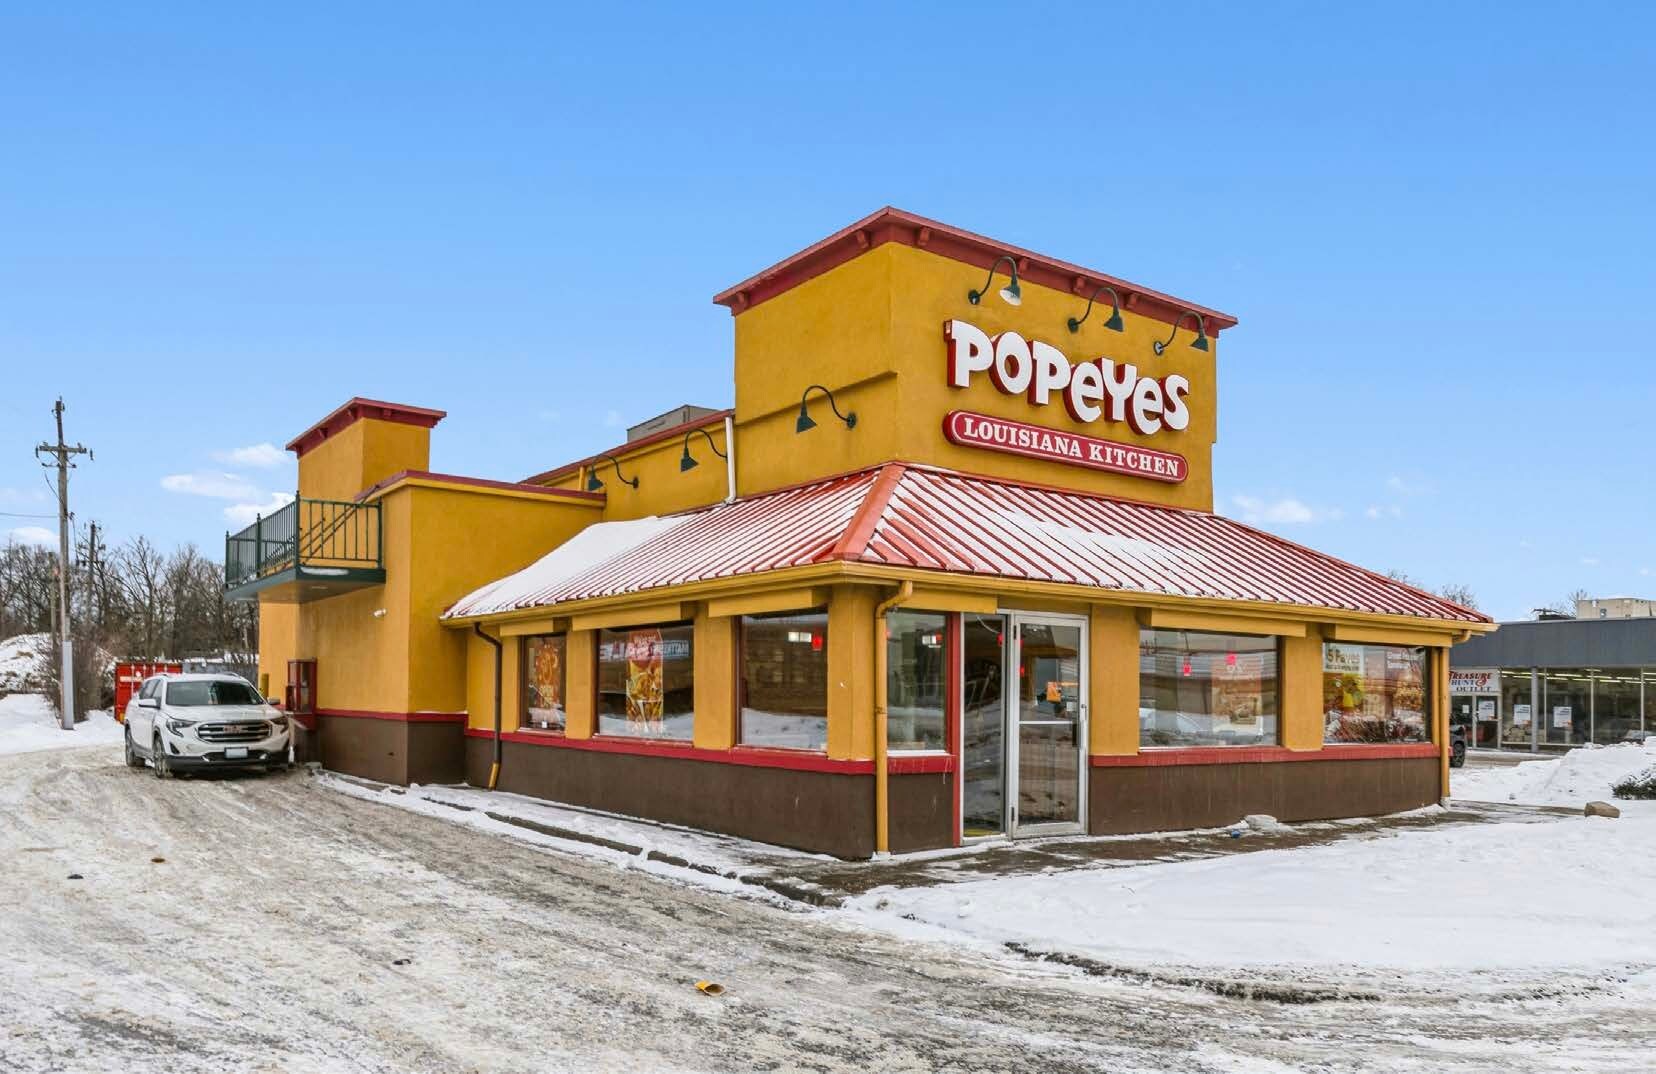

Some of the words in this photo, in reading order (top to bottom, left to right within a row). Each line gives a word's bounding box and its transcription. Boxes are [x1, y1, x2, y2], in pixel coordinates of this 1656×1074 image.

[963, 417, 1083, 458] LOUISIANA
[1088, 442, 1179, 477] KITCHEN
[1448, 671, 1492, 680] TREASURE
